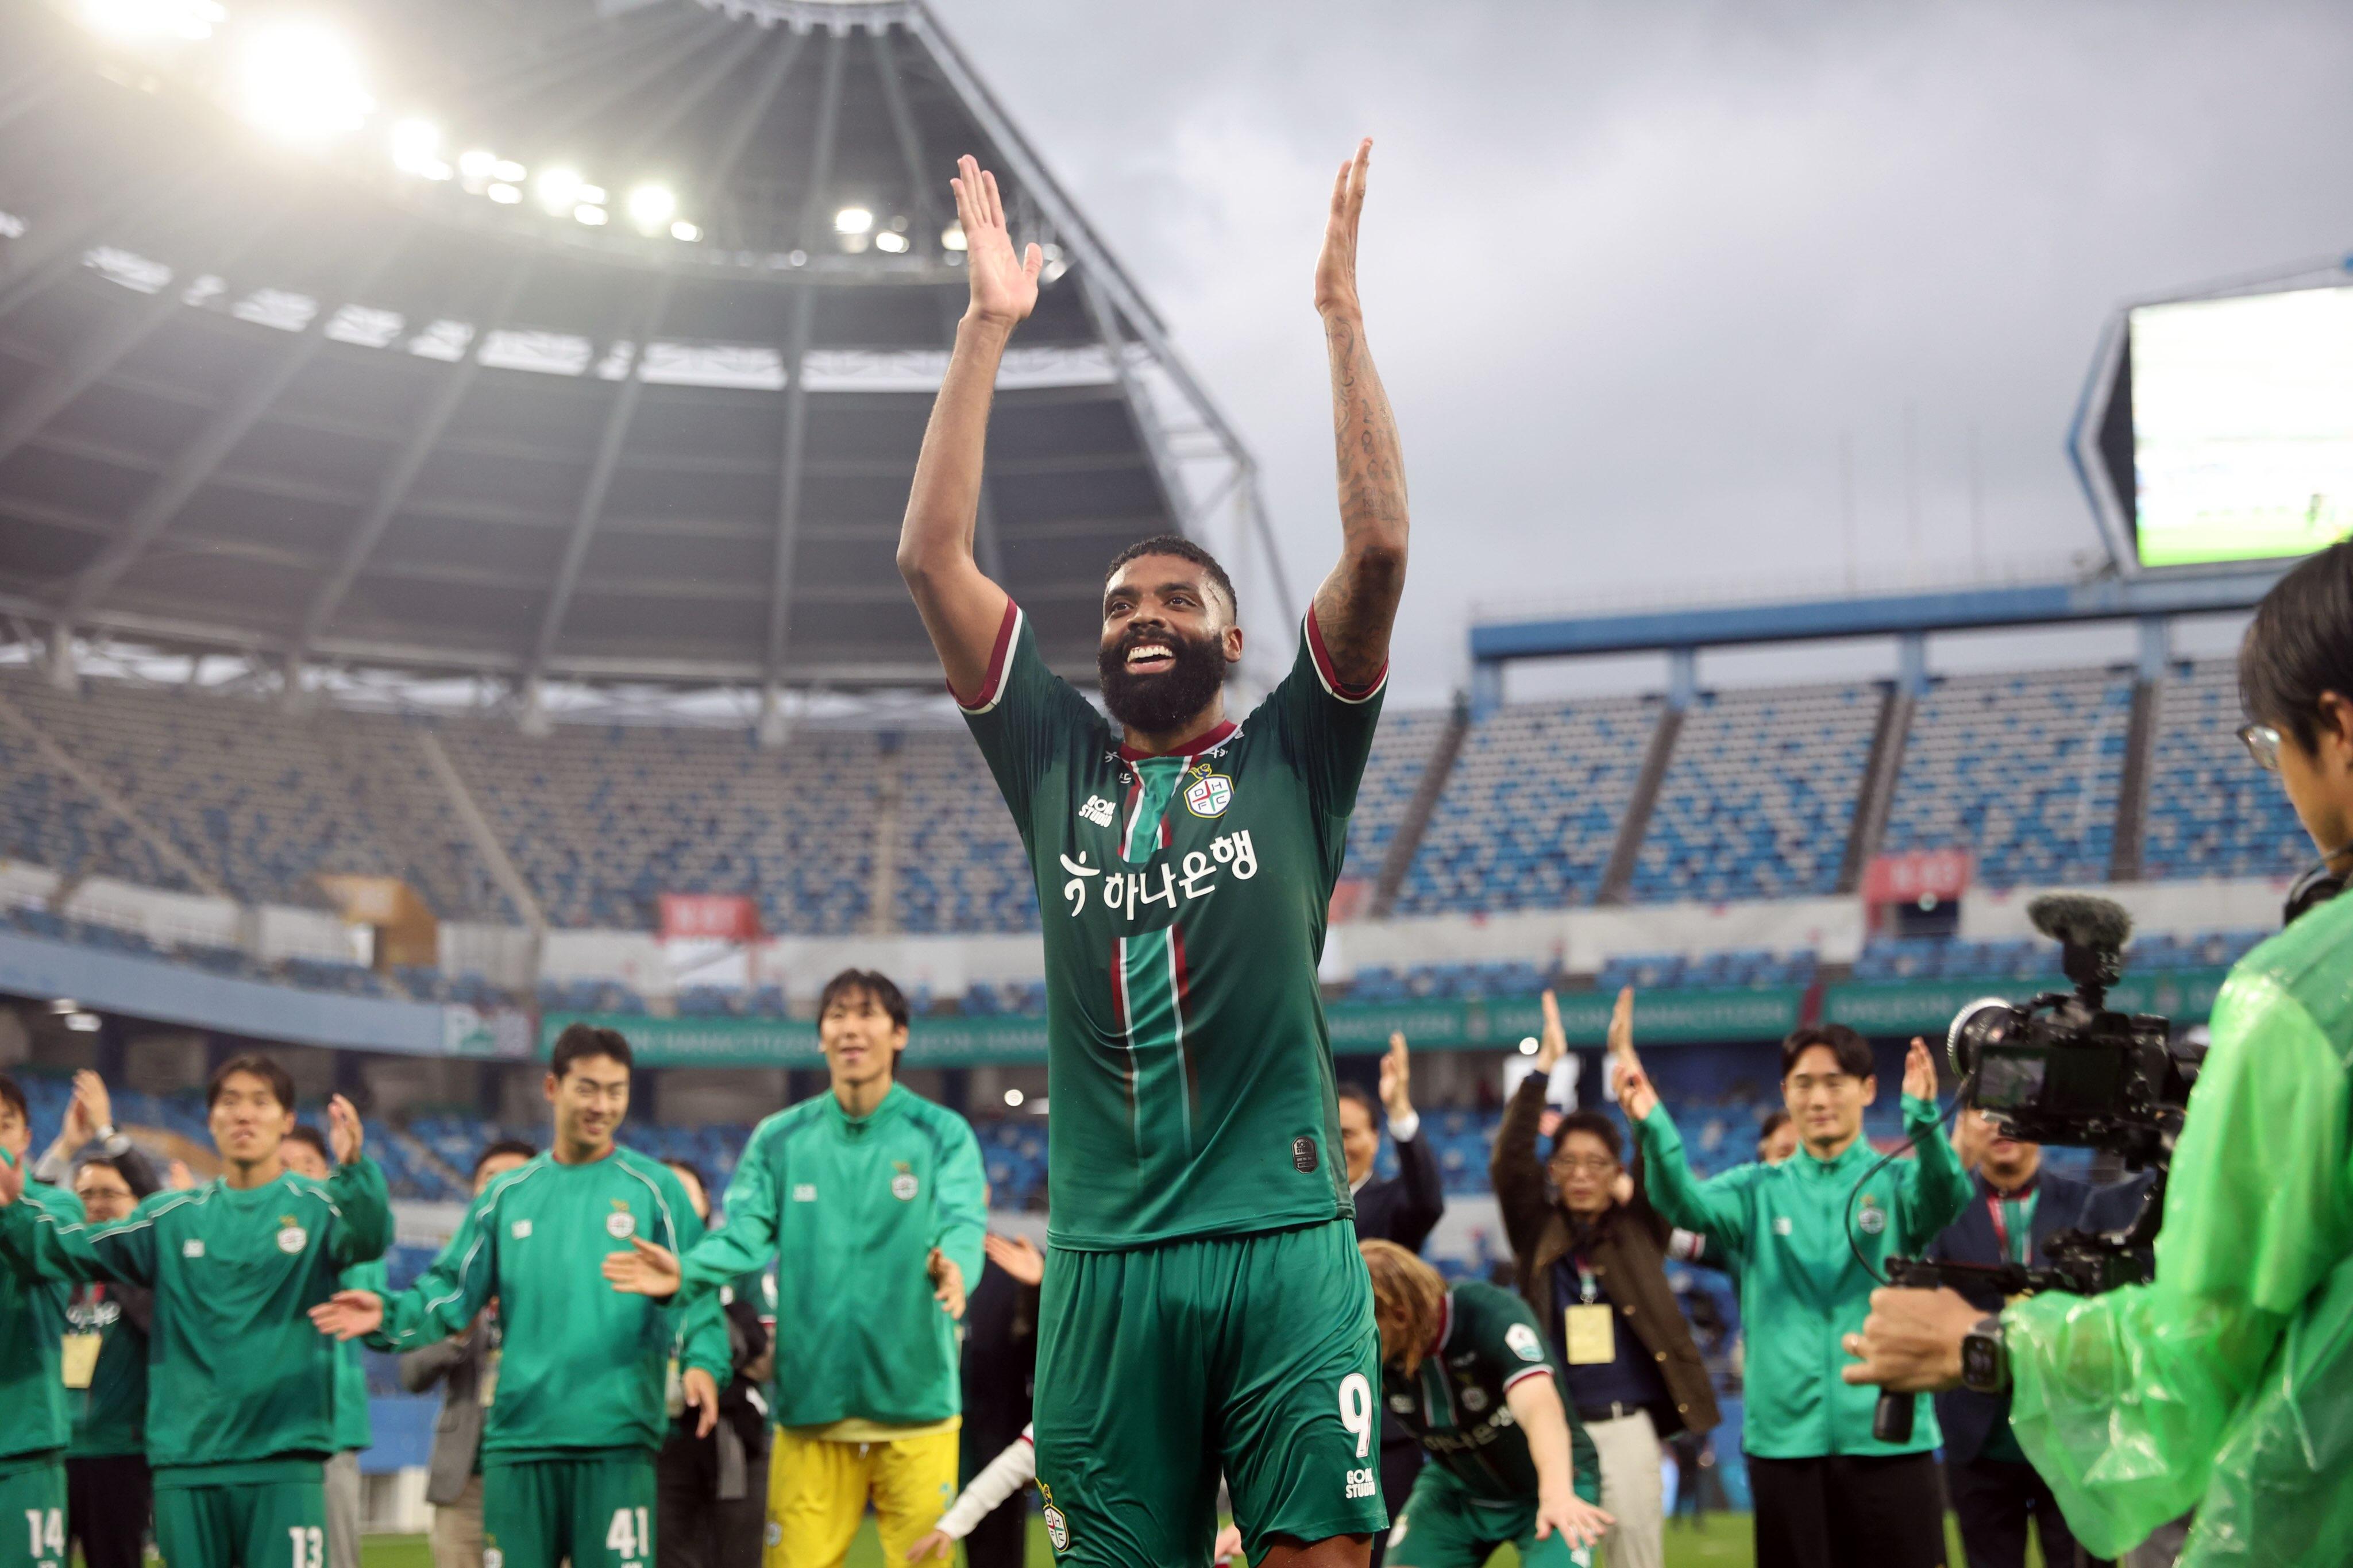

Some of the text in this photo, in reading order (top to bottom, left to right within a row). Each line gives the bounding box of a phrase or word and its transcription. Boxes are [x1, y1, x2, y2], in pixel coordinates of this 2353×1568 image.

[1087, 794, 1116, 816] GOAL
[1104, 829, 1258, 921] 하나은행
[1338, 1372, 1372, 1458] 9
[1346, 1467, 1374, 1484] GOAL
[24, 1507, 65, 1558] 14
[288, 1525, 323, 1568] 13
[605, 1507, 649, 1559] 41
